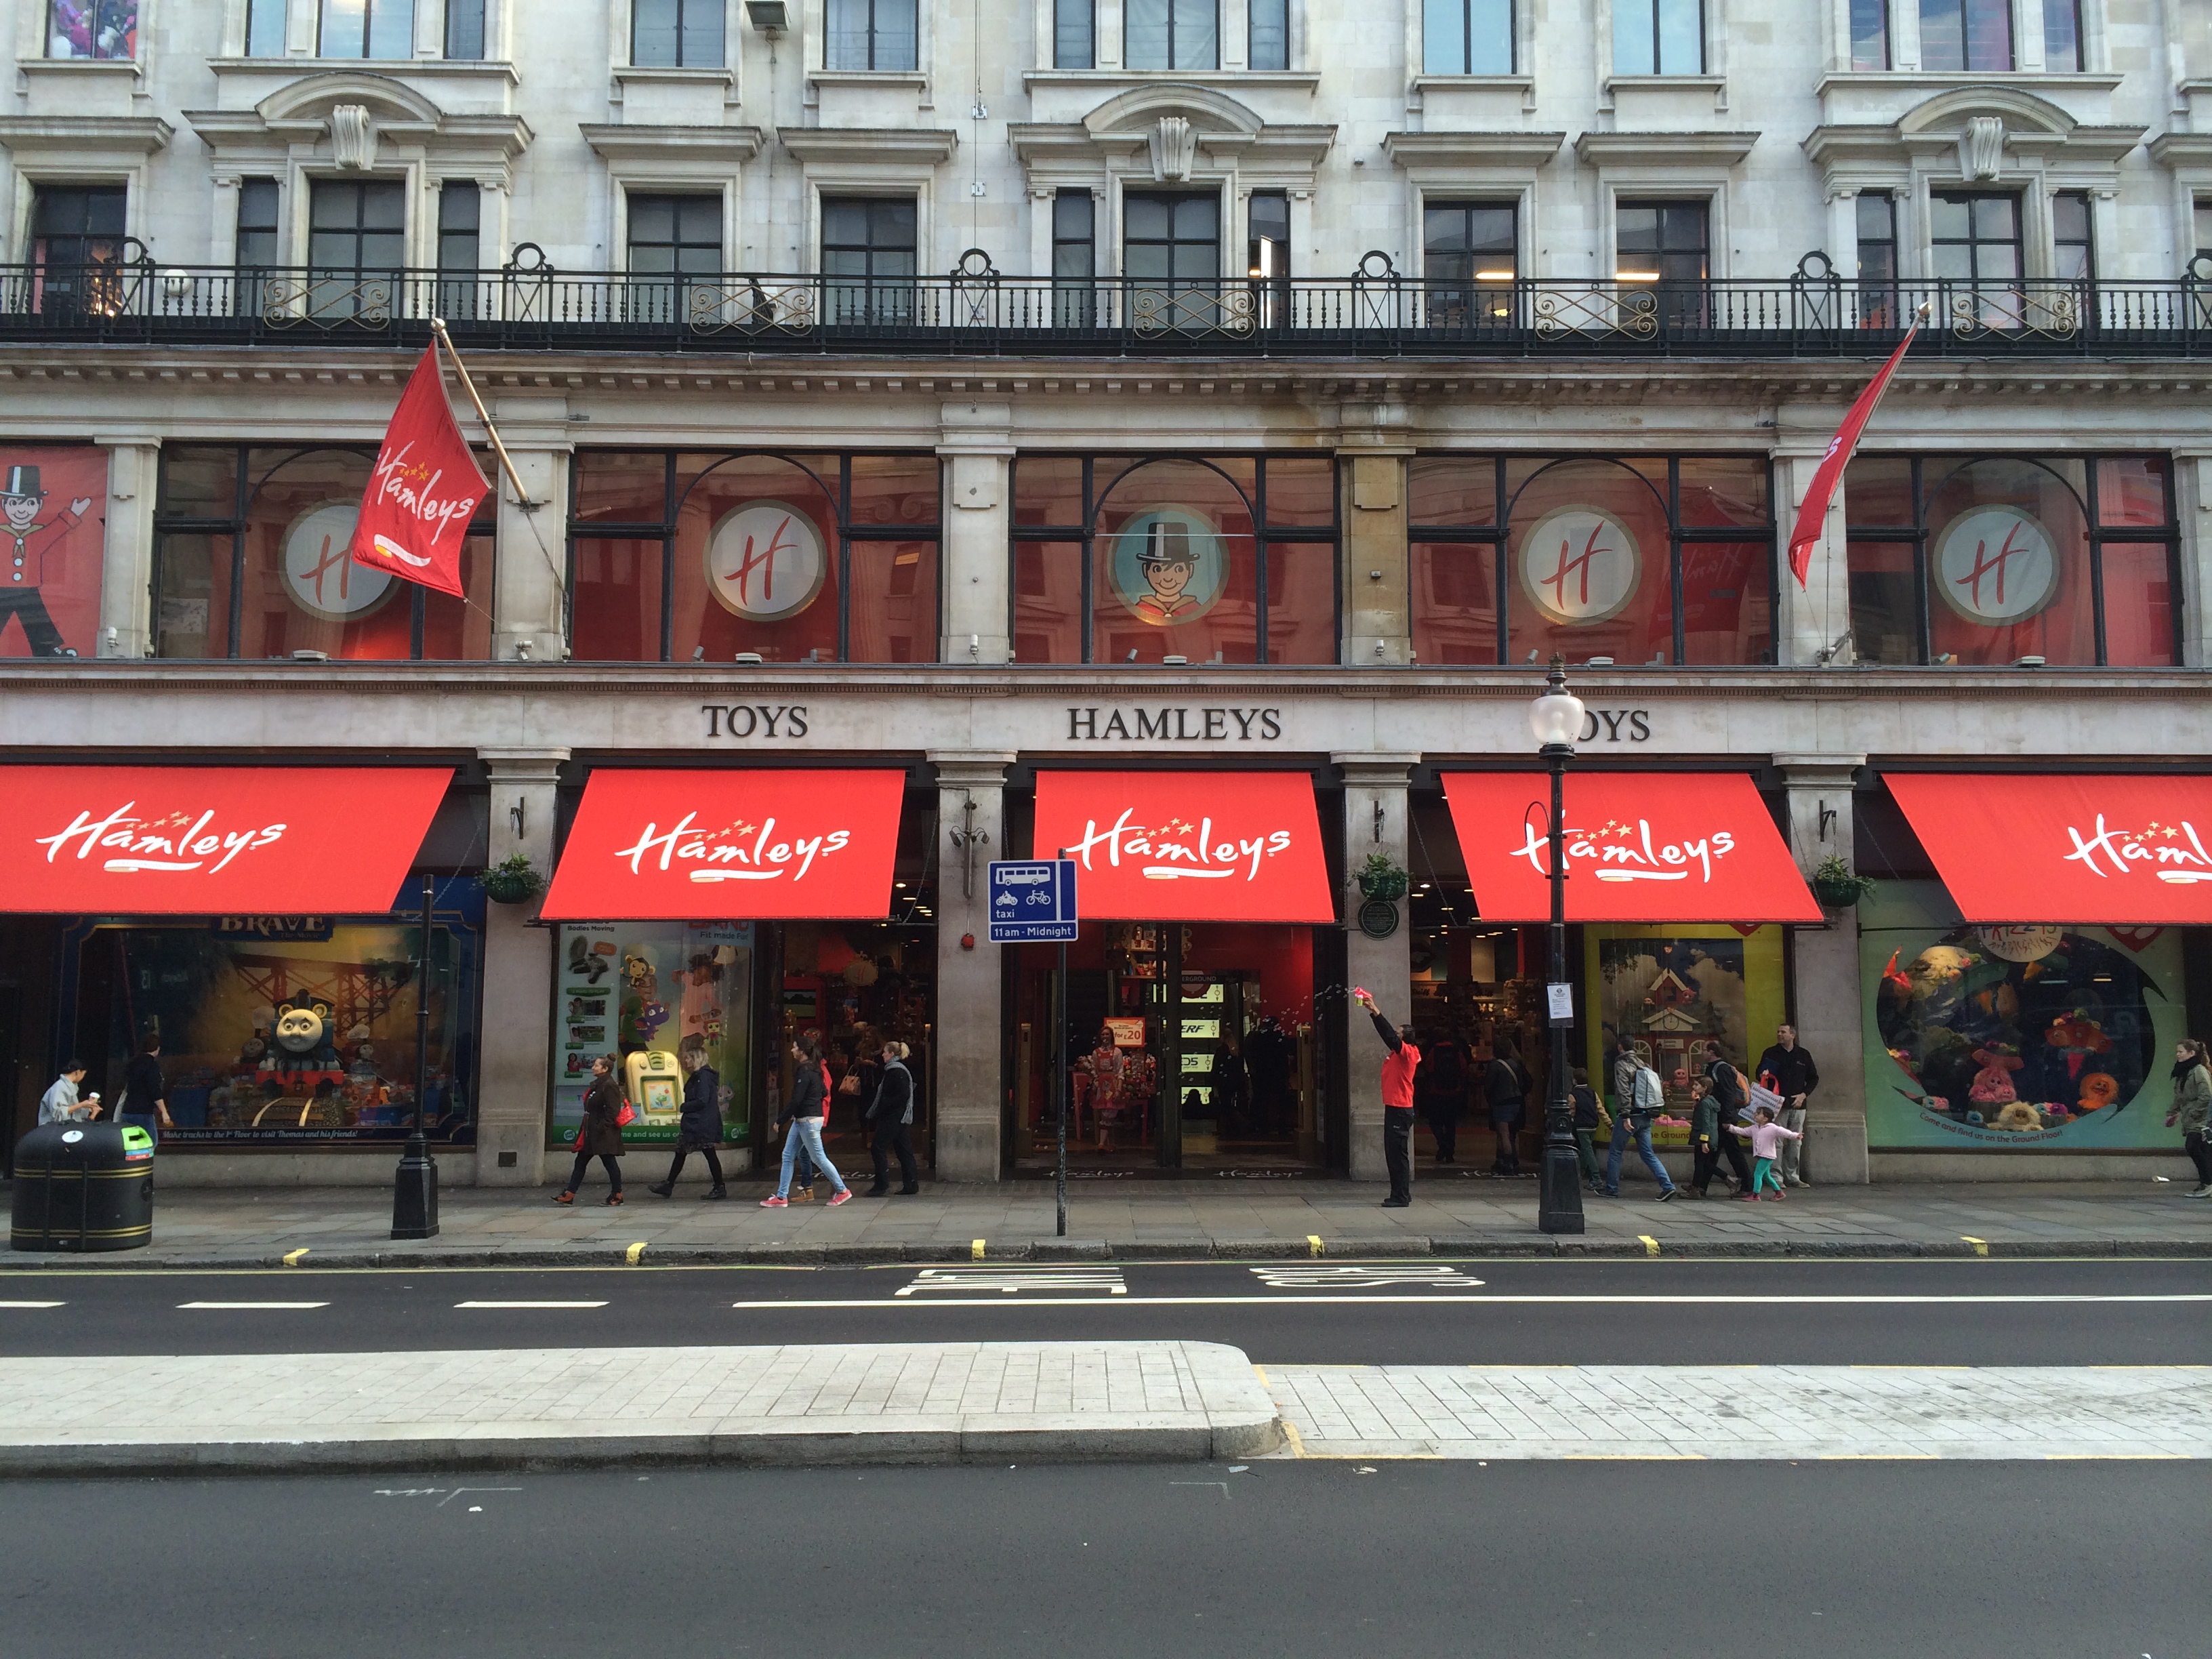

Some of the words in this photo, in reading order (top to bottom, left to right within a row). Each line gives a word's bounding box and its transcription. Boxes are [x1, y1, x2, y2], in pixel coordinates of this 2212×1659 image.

[376, 441, 474, 546] Hamleys
[724, 515, 798, 606] H
[1540, 519, 1613, 609] H
[1957, 520, 2029, 610] H
[702, 705, 808, 738] TOYS
[1067, 708, 1282, 740] HAMLEYS
[1578, 710, 1650, 741] OYS
[35, 800, 287, 874] Hamleys
[615, 811, 851, 882] Hamleys
[1065, 807, 1290, 881] Hamleys
[1509, 809, 1736, 883] Hamleys
[996, 909, 1015, 918] taxi
[1027, 926, 1071, 937] Midnight
[1124, 1031, 1141, 1040] £20
[1181, 1025, 1205, 1033] ERF
[278, 1130, 304, 1138] Thomas
[329, 1130, 359, 1139] friends!
[1919, 1112, 1940, 1126] Come
[1942, 1124, 1957, 1132] and
[1958, 1128, 1973, 1137] find
[2012, 1134, 2039, 1143] Ground
[2041, 1129, 2063, 1140] Floor!
